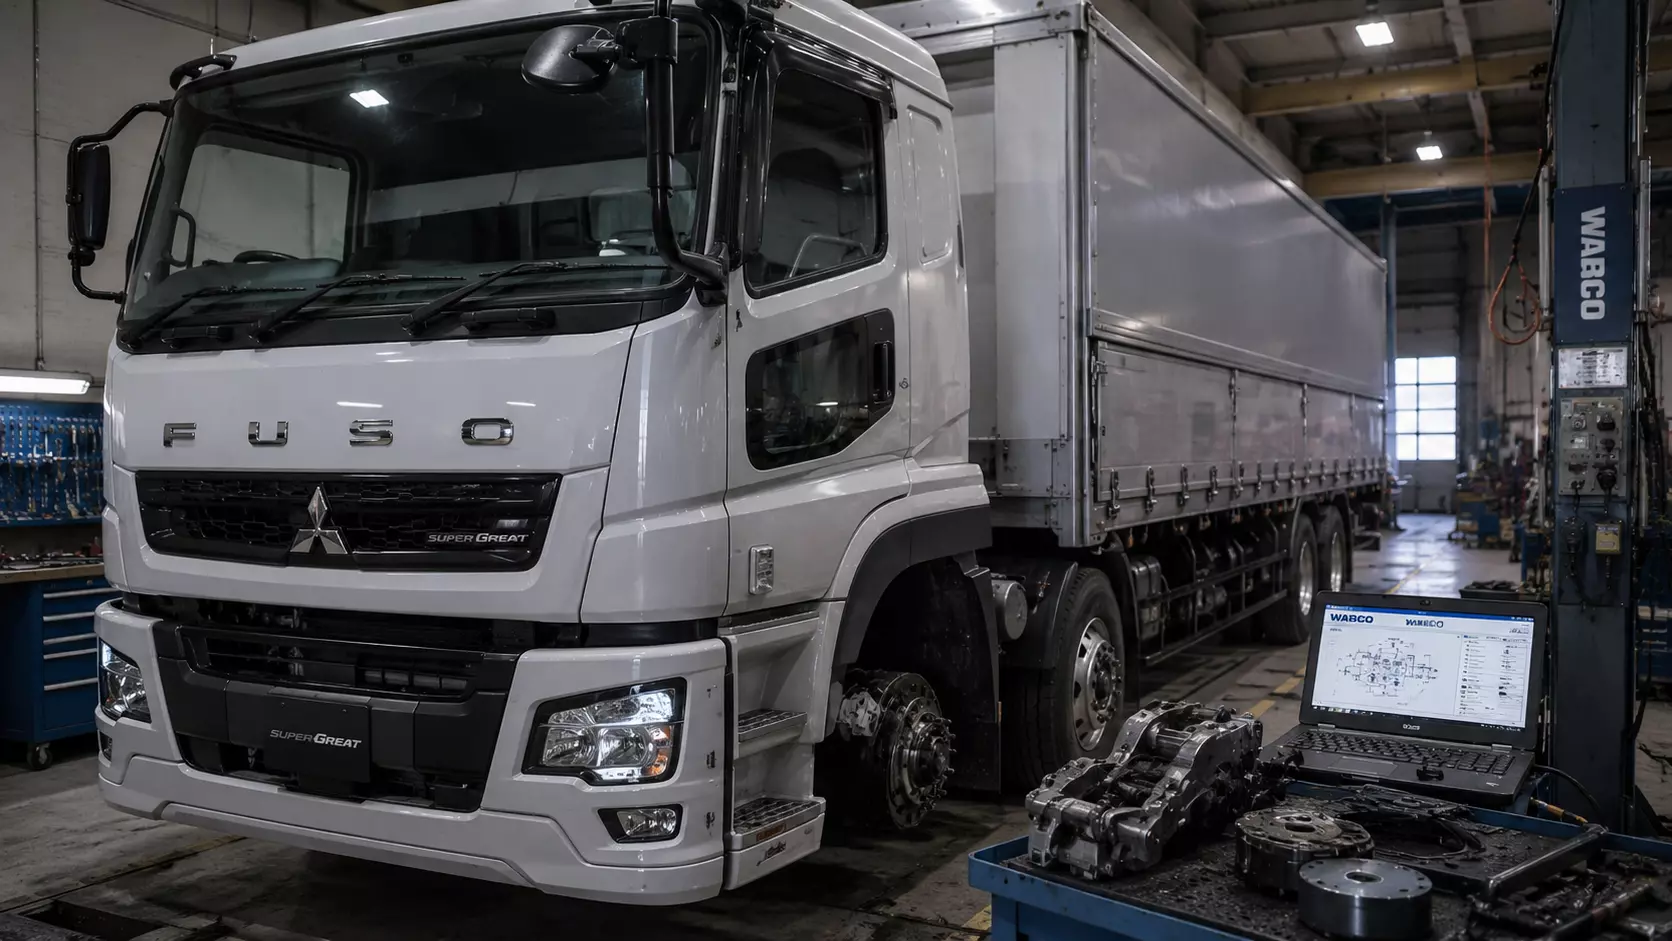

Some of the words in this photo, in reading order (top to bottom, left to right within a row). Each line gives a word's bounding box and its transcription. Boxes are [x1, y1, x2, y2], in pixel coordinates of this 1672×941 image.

[1580, 206, 1606, 320] WABCO
[164, 417, 515, 448] FUSO
[428, 534, 474, 543] SUPER
[475, 532, 529, 543] GREAT
[1330, 613, 1374, 624] WABCO
[269, 729, 313, 742] SUPER
[313, 732, 362, 749] GREAT
